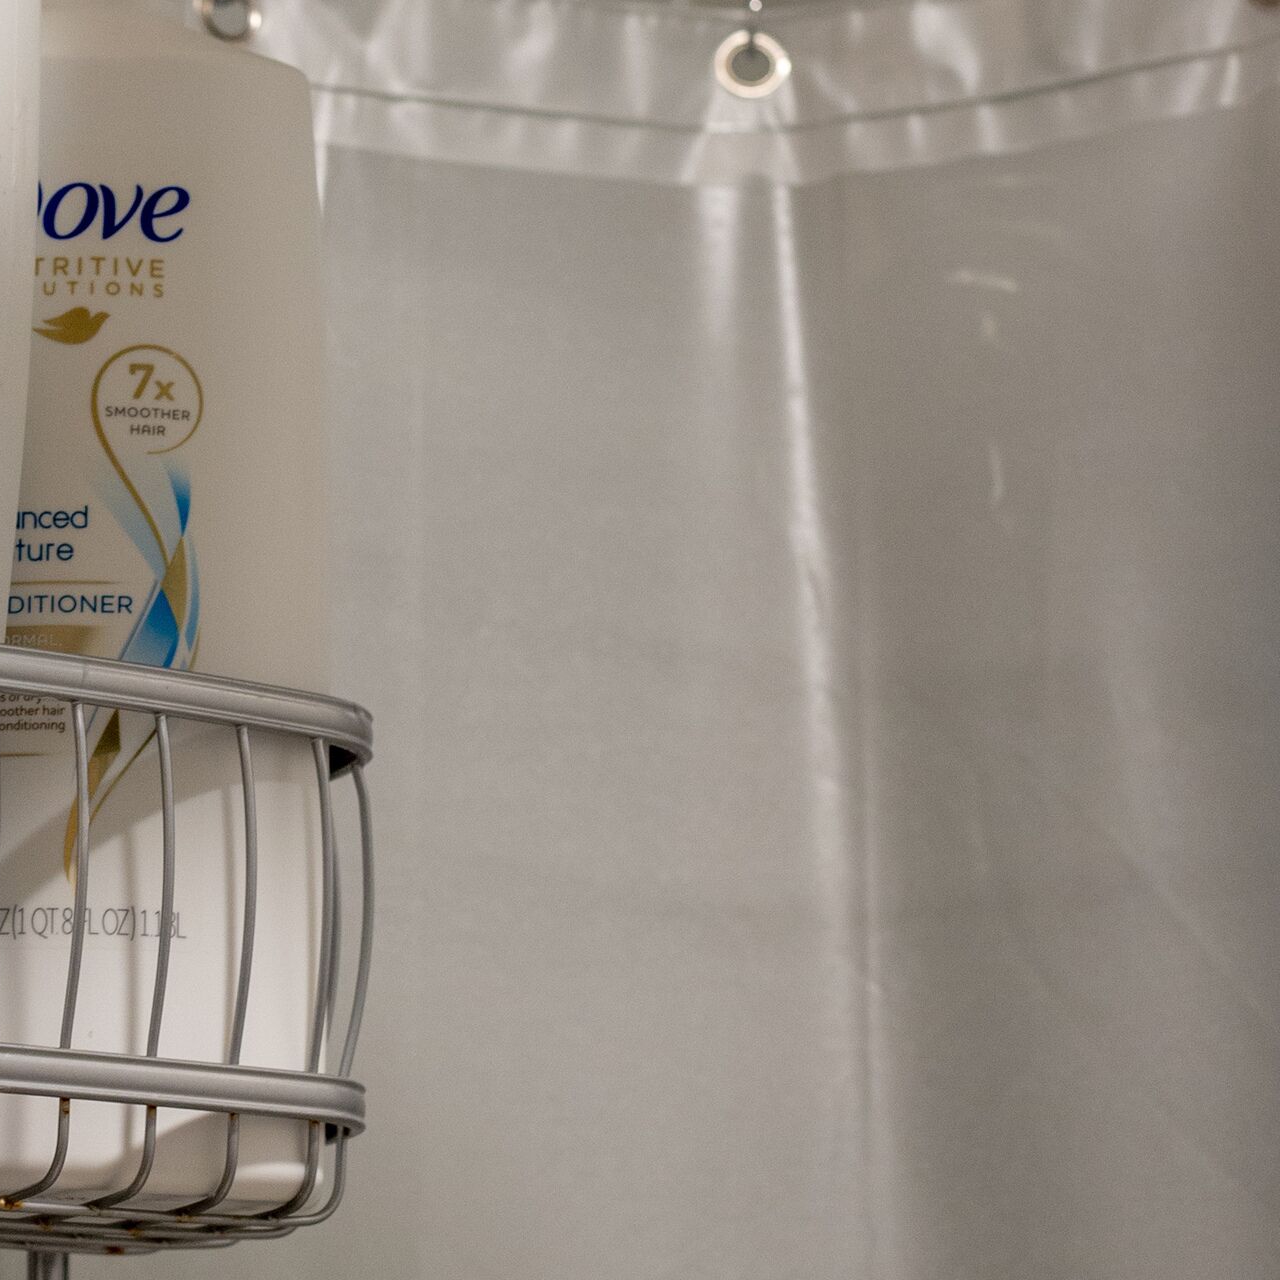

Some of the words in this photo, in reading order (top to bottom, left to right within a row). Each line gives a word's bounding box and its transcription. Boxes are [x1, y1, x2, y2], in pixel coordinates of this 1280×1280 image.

[37, 181, 190, 243] ove
[42, 280, 165, 298] UTIONS
[129, 363, 175, 401] 7x
[105, 406, 190, 421] SMOOTHER
[129, 424, 166, 436] HAIR
[8, 594, 134, 615] DITIONER
[42, 705, 66, 716] hair
